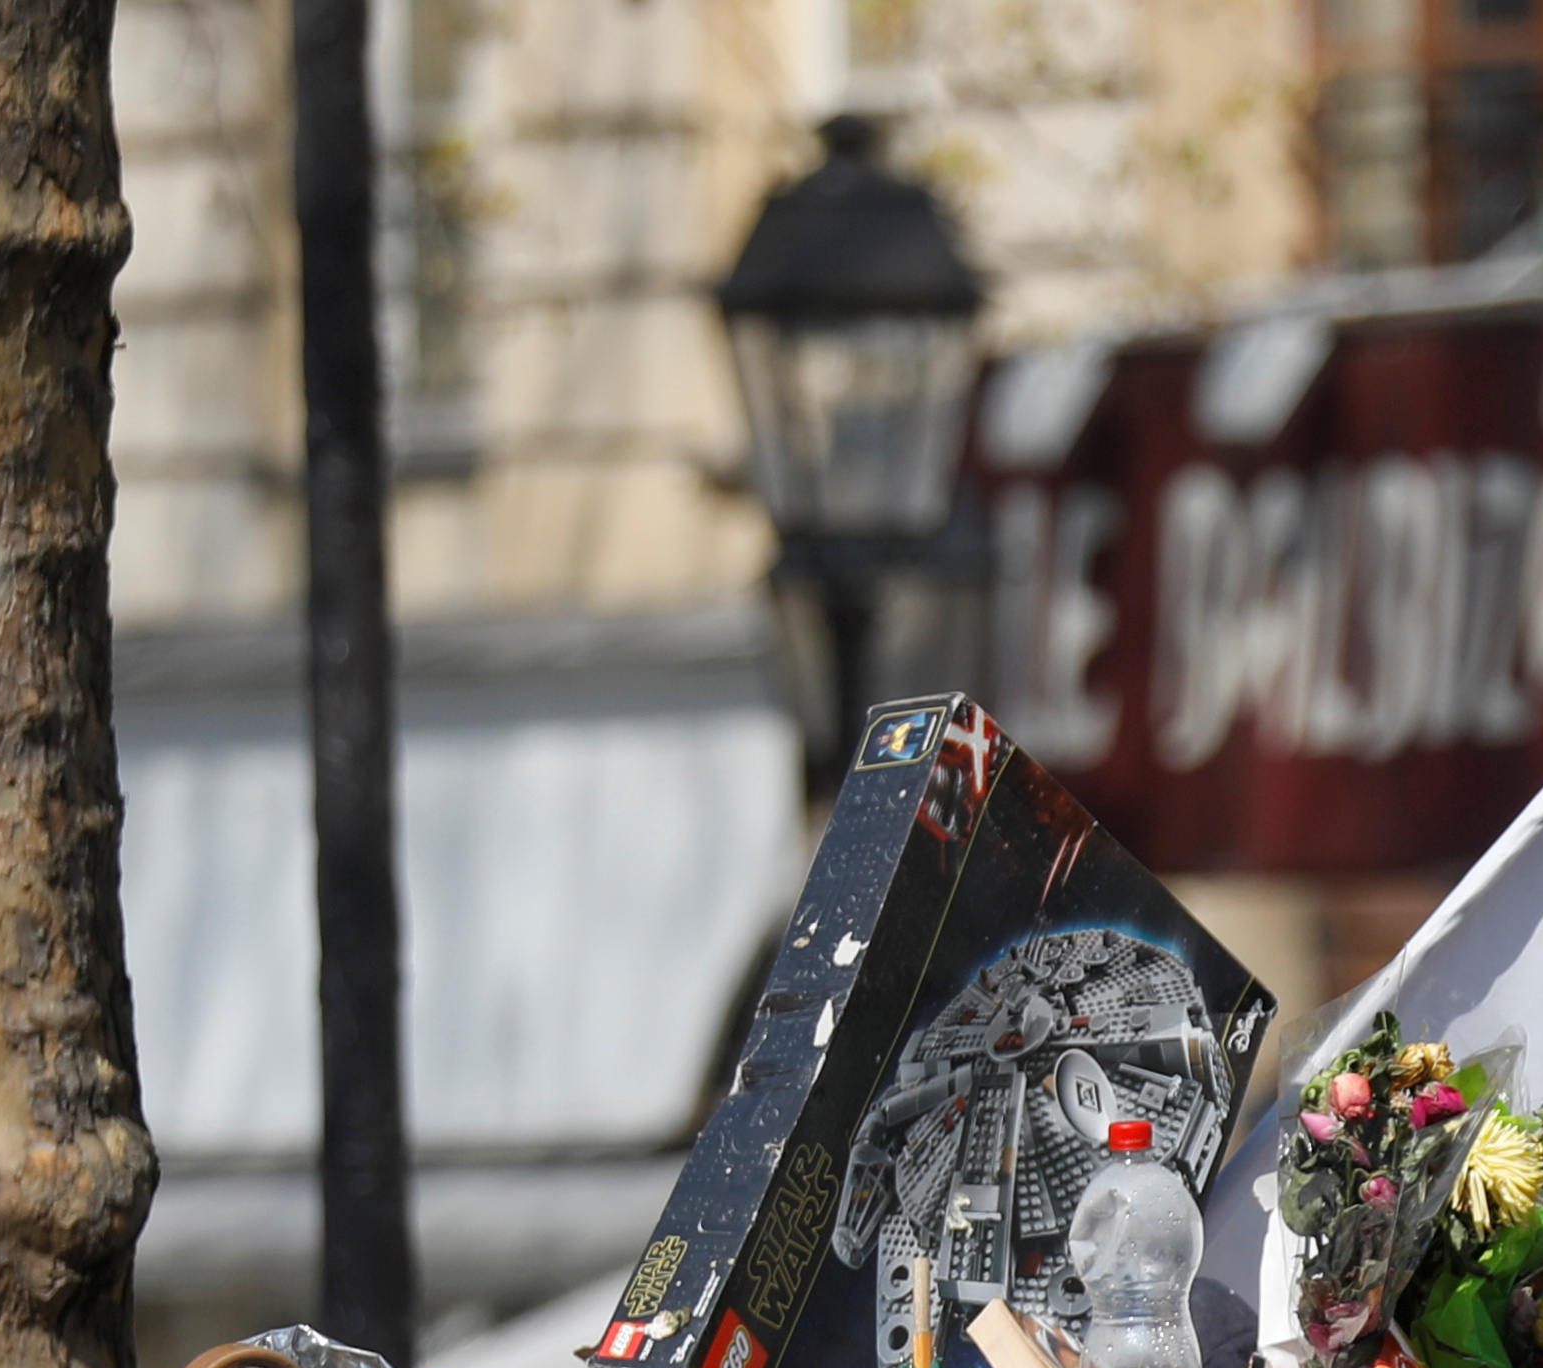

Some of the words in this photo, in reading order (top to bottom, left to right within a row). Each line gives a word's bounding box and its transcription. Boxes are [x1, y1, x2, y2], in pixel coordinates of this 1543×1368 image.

[747, 1141, 824, 1314] STAR
[756, 1153, 839, 1330] WARS
[624, 1236, 680, 1309] STAR
[629, 1241, 688, 1318] WARS
[610, 1323, 635, 1357] LEGO
